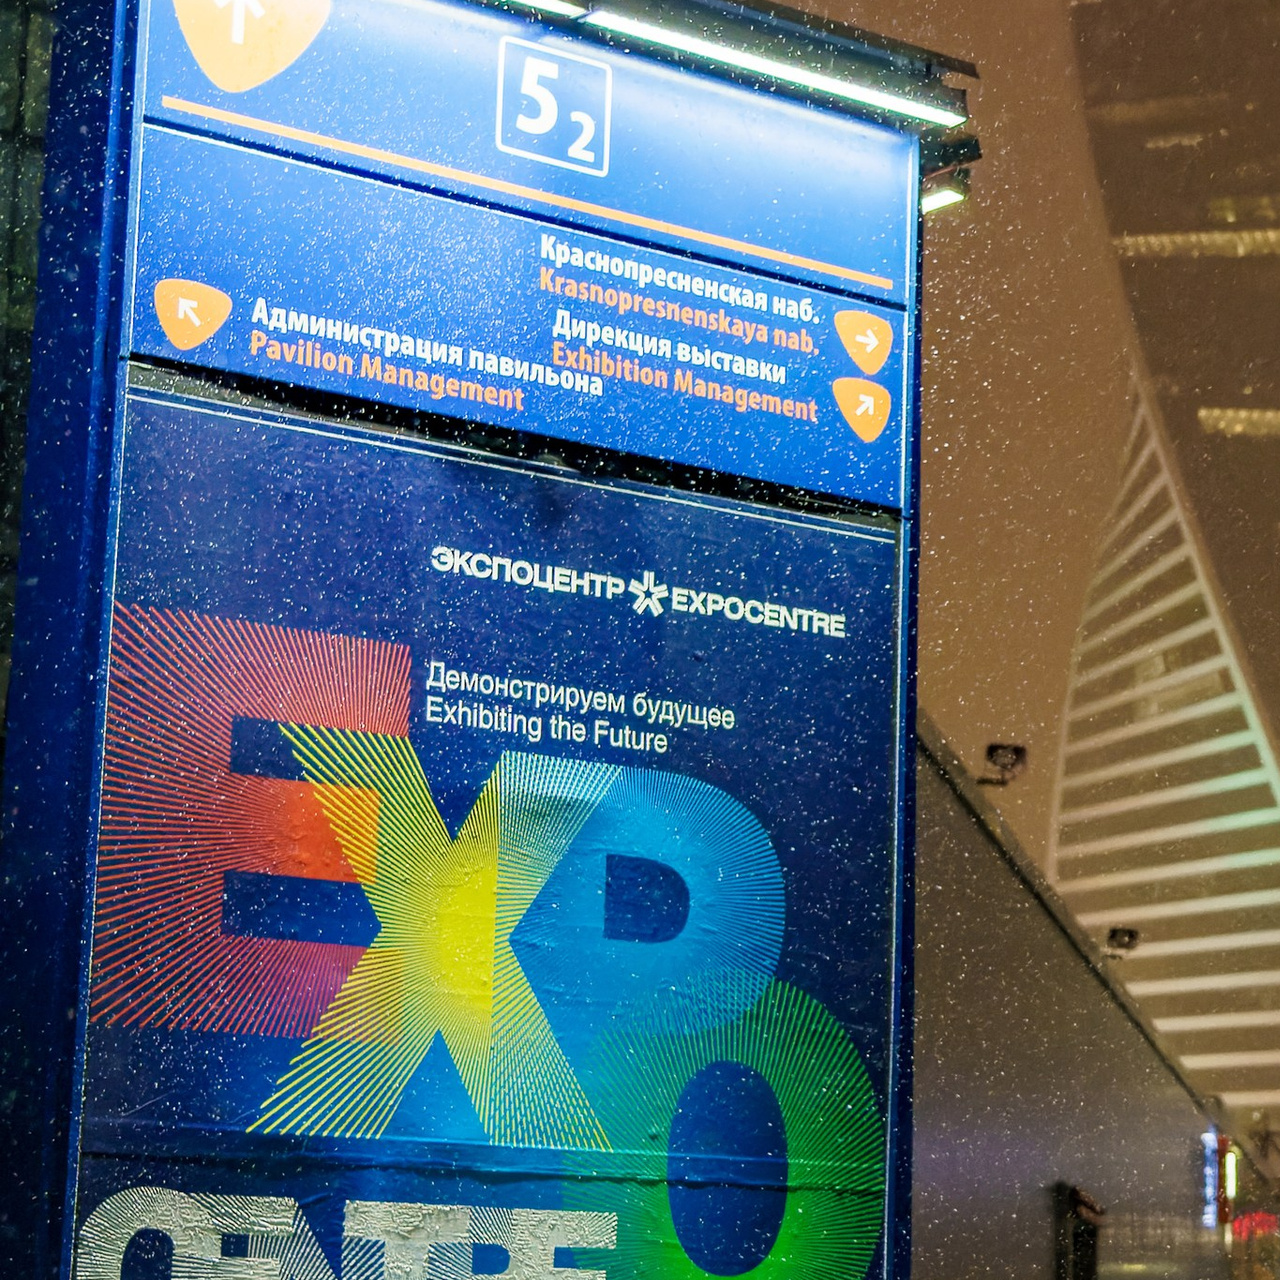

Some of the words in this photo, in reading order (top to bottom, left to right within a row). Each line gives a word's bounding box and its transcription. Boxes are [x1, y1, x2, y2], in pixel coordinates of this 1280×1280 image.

[539, 266, 768, 345] Krasnopresnenskaya
[773, 329, 820, 356] nab.
[540, 233, 767, 312] Краснопресненская
[771, 294, 821, 324] наб.
[249, 330, 353, 376] Pavilion
[359, 353, 525, 412] Management
[251, 297, 464, 367] Администрация
[468, 349, 604, 397] павильона
[552, 308, 672, 360] Дирекция
[676, 342, 787, 385] выставки
[552, 341, 668, 390] Exhibition
[673, 368, 819, 422] Management
[431, 545, 625, 600] ЭКСПОЦЕНТР
[671, 587, 847, 639] EXPOCENTRE
[426, 661, 626, 717] Демонстрируем
[632, 696, 736, 732] будущее
[426, 697, 543, 742] Exhibiting
[549, 713, 587, 742] the
[594, 720, 669, 754] Future
